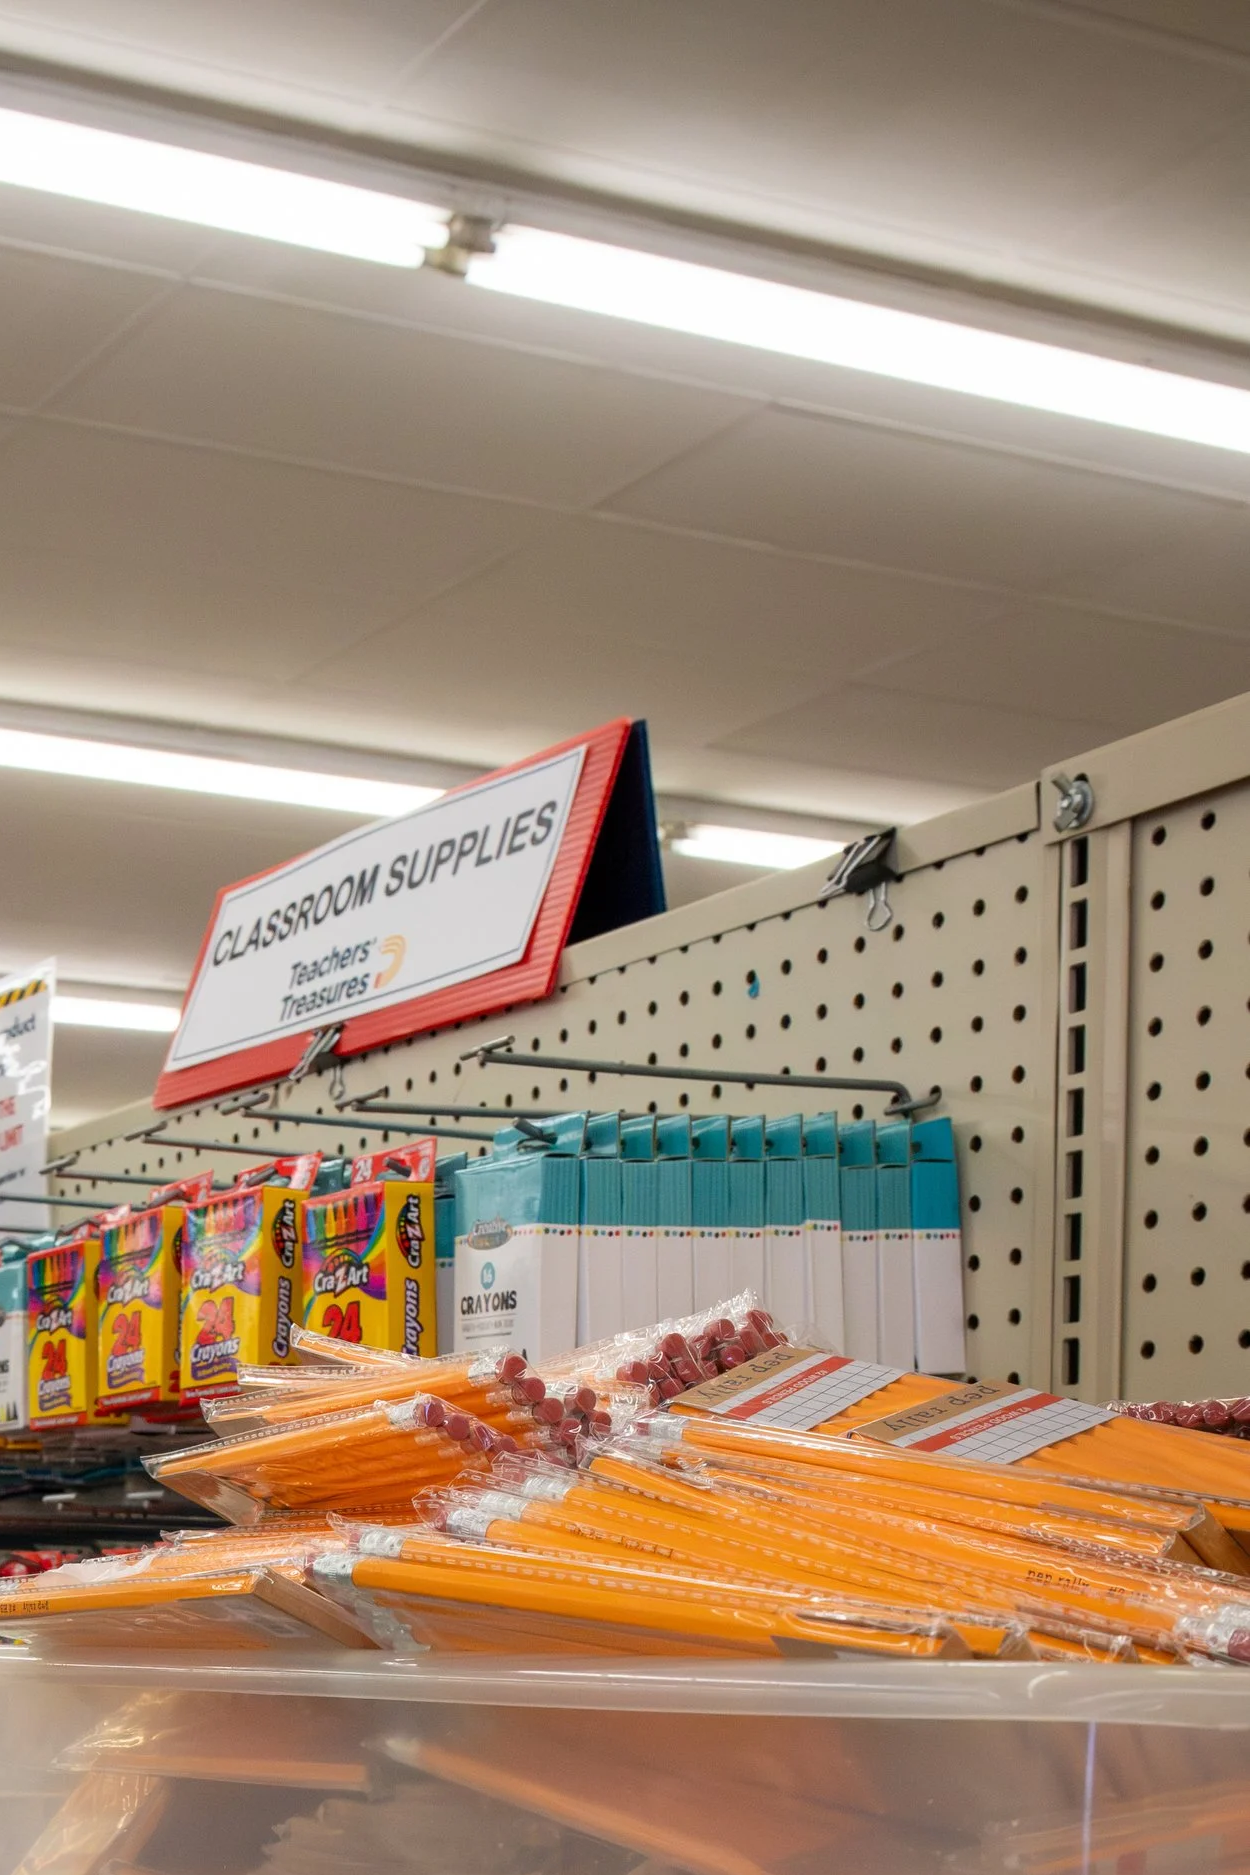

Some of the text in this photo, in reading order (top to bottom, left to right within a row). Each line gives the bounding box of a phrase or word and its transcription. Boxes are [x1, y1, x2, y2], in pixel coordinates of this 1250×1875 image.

[212, 799, 557, 967] CLASSROOM SUPPLIES
[288, 938, 378, 990] Teachers'
[279, 971, 370, 1022] Treasures
[0, 1124, 25, 1152] LIMIT
[354, 1159, 372, 1183] 24
[272, 1275, 293, 1359] Crayons
[460, 1290, 518, 1315] CRAYONS
[111, 1311, 143, 1355] 24
[196, 1296, 236, 1345] 24
[322, 1301, 363, 1343] 24
[40, 1339, 68, 1381] 24
[189, 1337, 240, 1366] Crayons
[751, 1352, 795, 1373] pep
[697, 1375, 752, 1401] rally
[947, 1385, 1000, 1406] pep
[883, 1406, 948, 1431] rally
